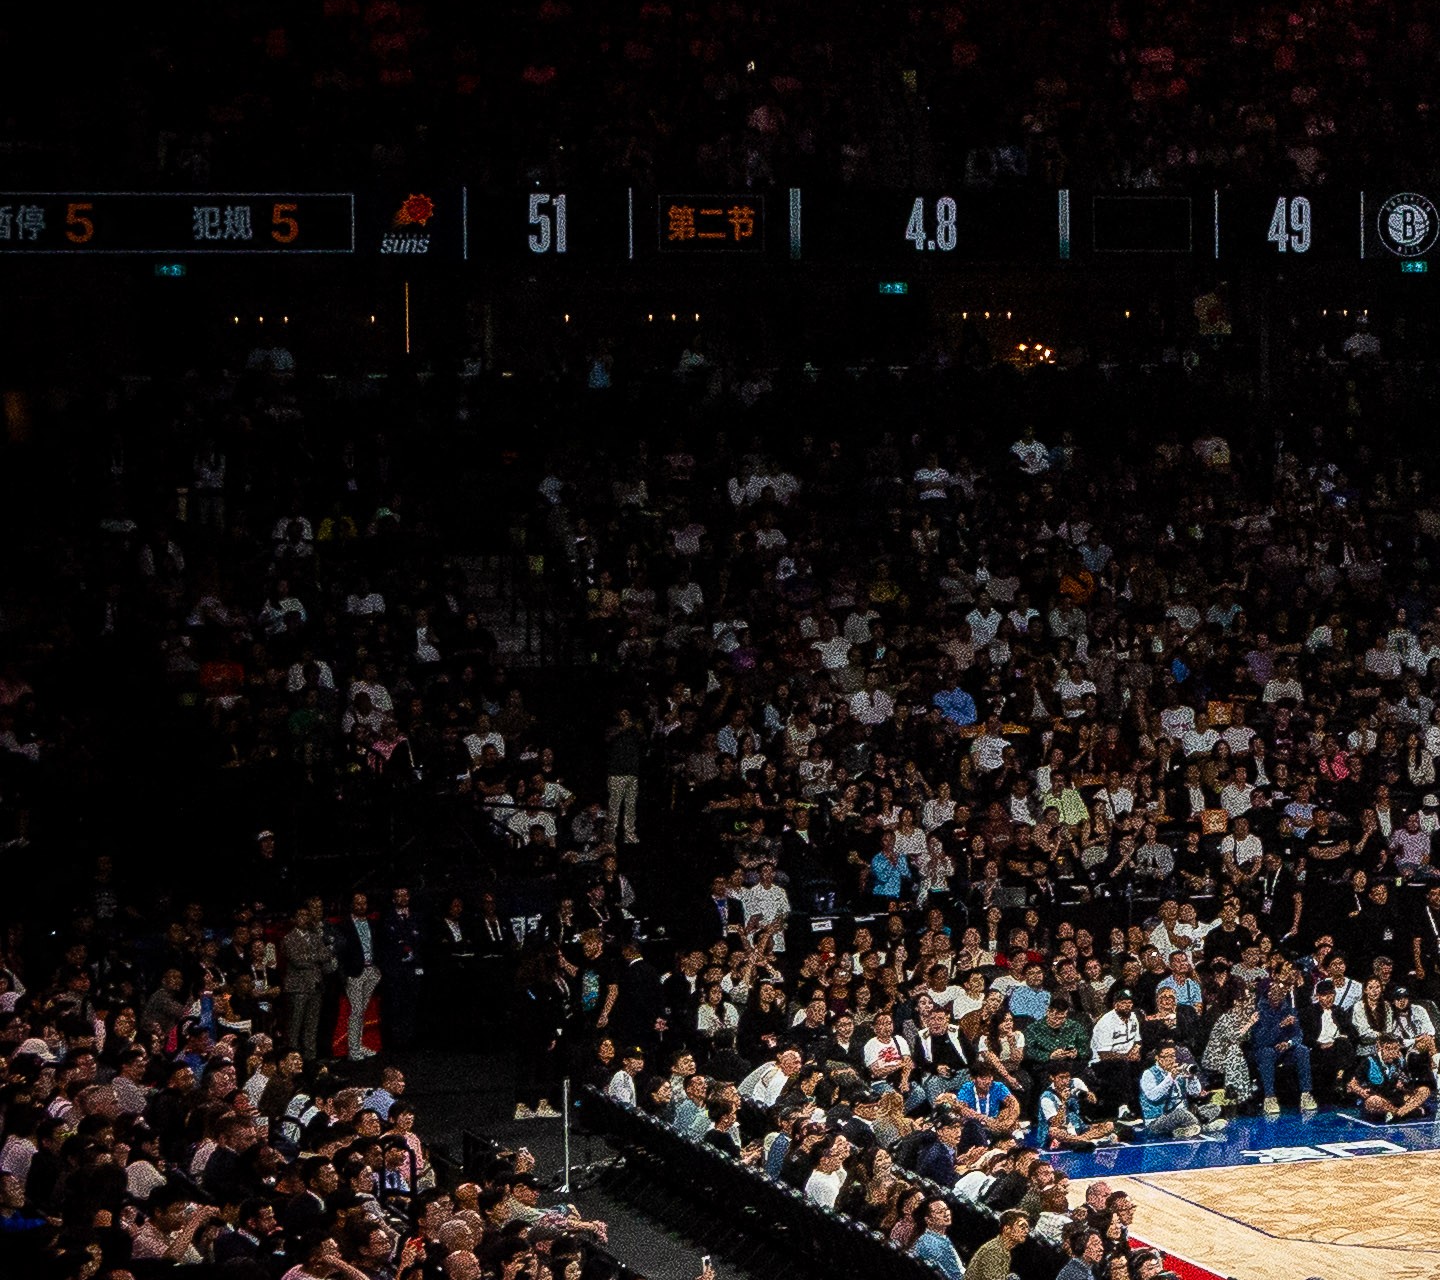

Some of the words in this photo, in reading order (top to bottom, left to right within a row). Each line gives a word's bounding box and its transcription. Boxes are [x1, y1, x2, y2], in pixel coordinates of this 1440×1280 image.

[66, 203, 94, 244] 5
[193, 205, 252, 241] 犯规
[271, 203, 299, 244] 5
[528, 193, 567, 254] 51
[667, 204, 755, 241] 第二节
[905, 196, 957, 251] 4.8
[1267, 197, 1311, 253] 49
